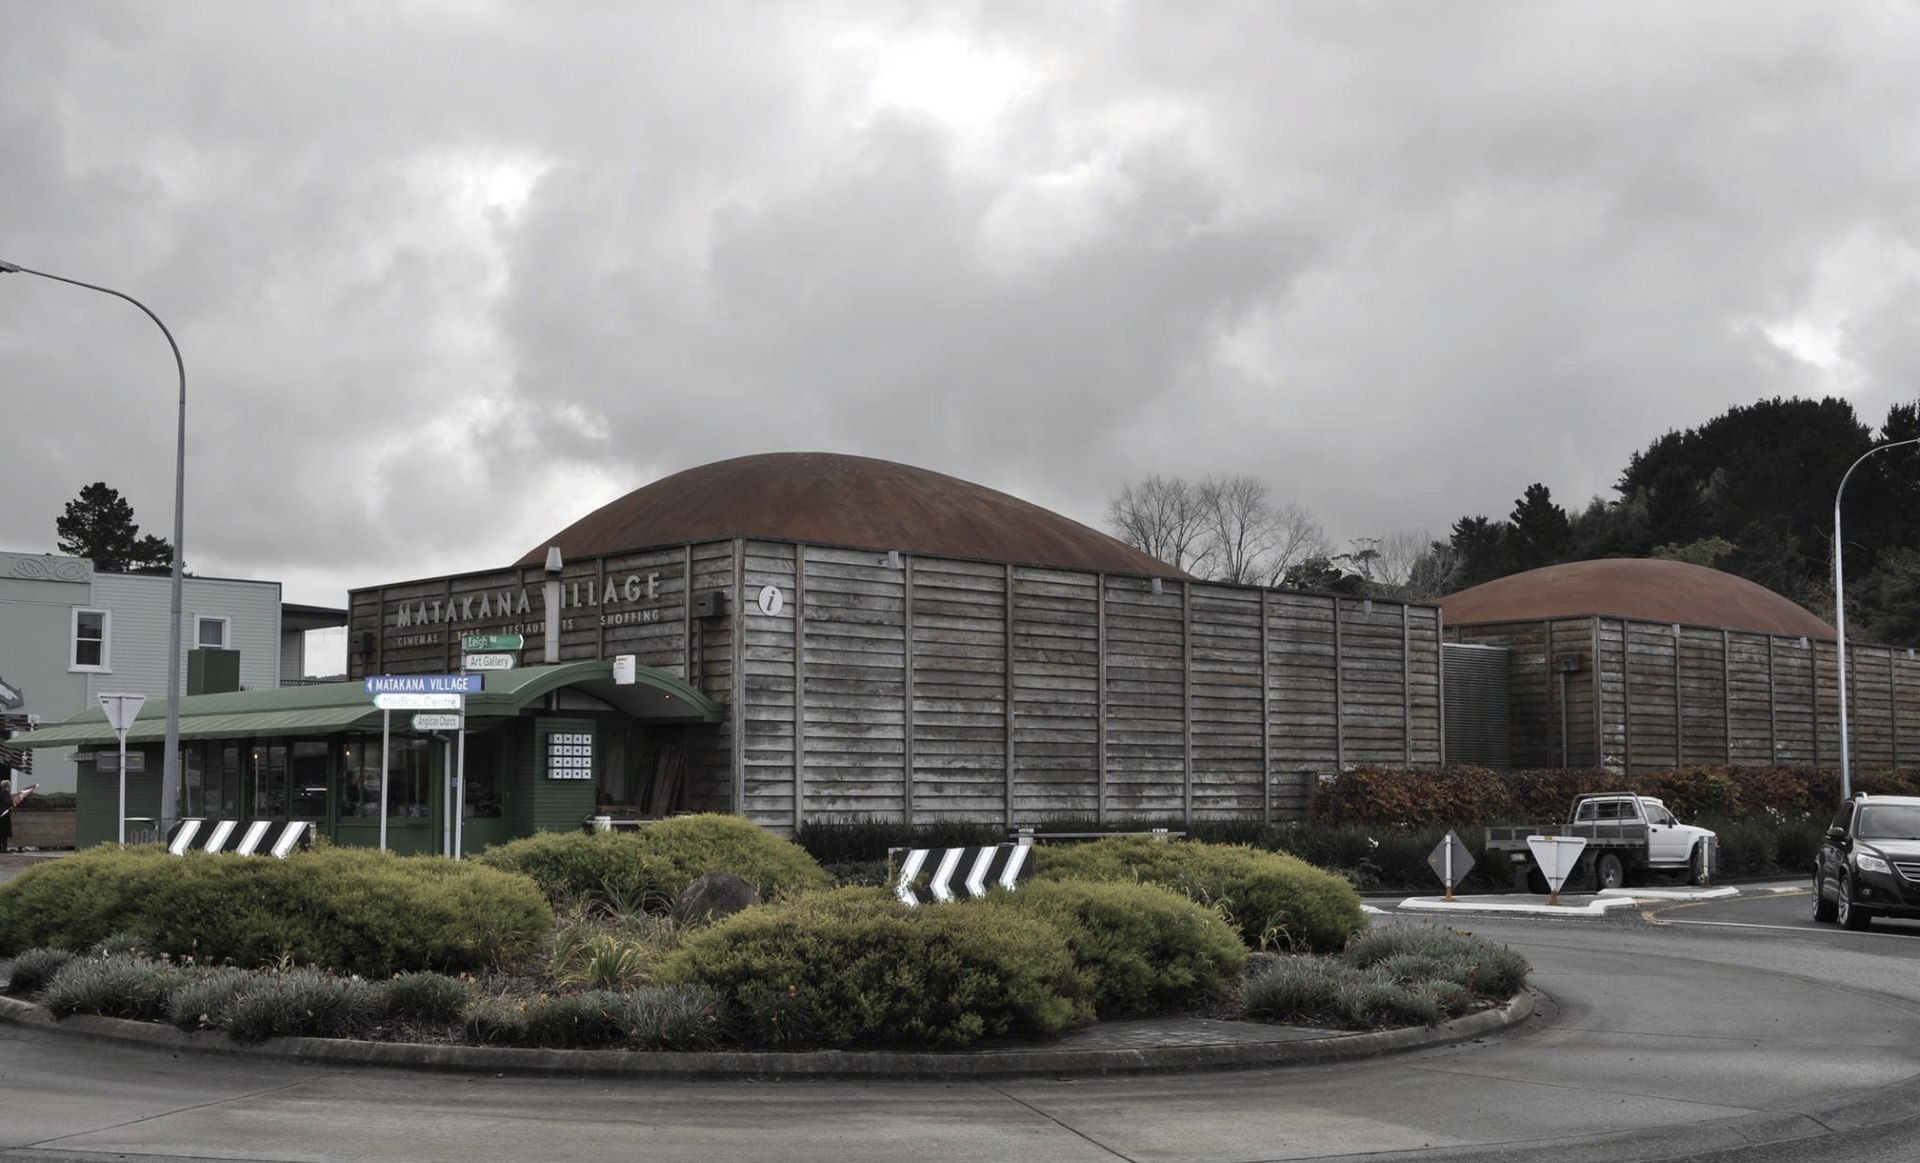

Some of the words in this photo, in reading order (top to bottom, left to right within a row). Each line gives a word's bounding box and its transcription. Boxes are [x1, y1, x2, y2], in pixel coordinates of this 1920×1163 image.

[397, 588, 531, 628] MATAKANA
[502, 619, 574, 636] RESTAURTS
[469, 635, 488, 649] Leigh
[470, 656, 482, 667] Art
[483, 656, 509, 668] Gallery
[375, 678, 426, 692] MATAKANA
[429, 677, 469, 692] VILLAGE
[424, 695, 457, 707] Centre
